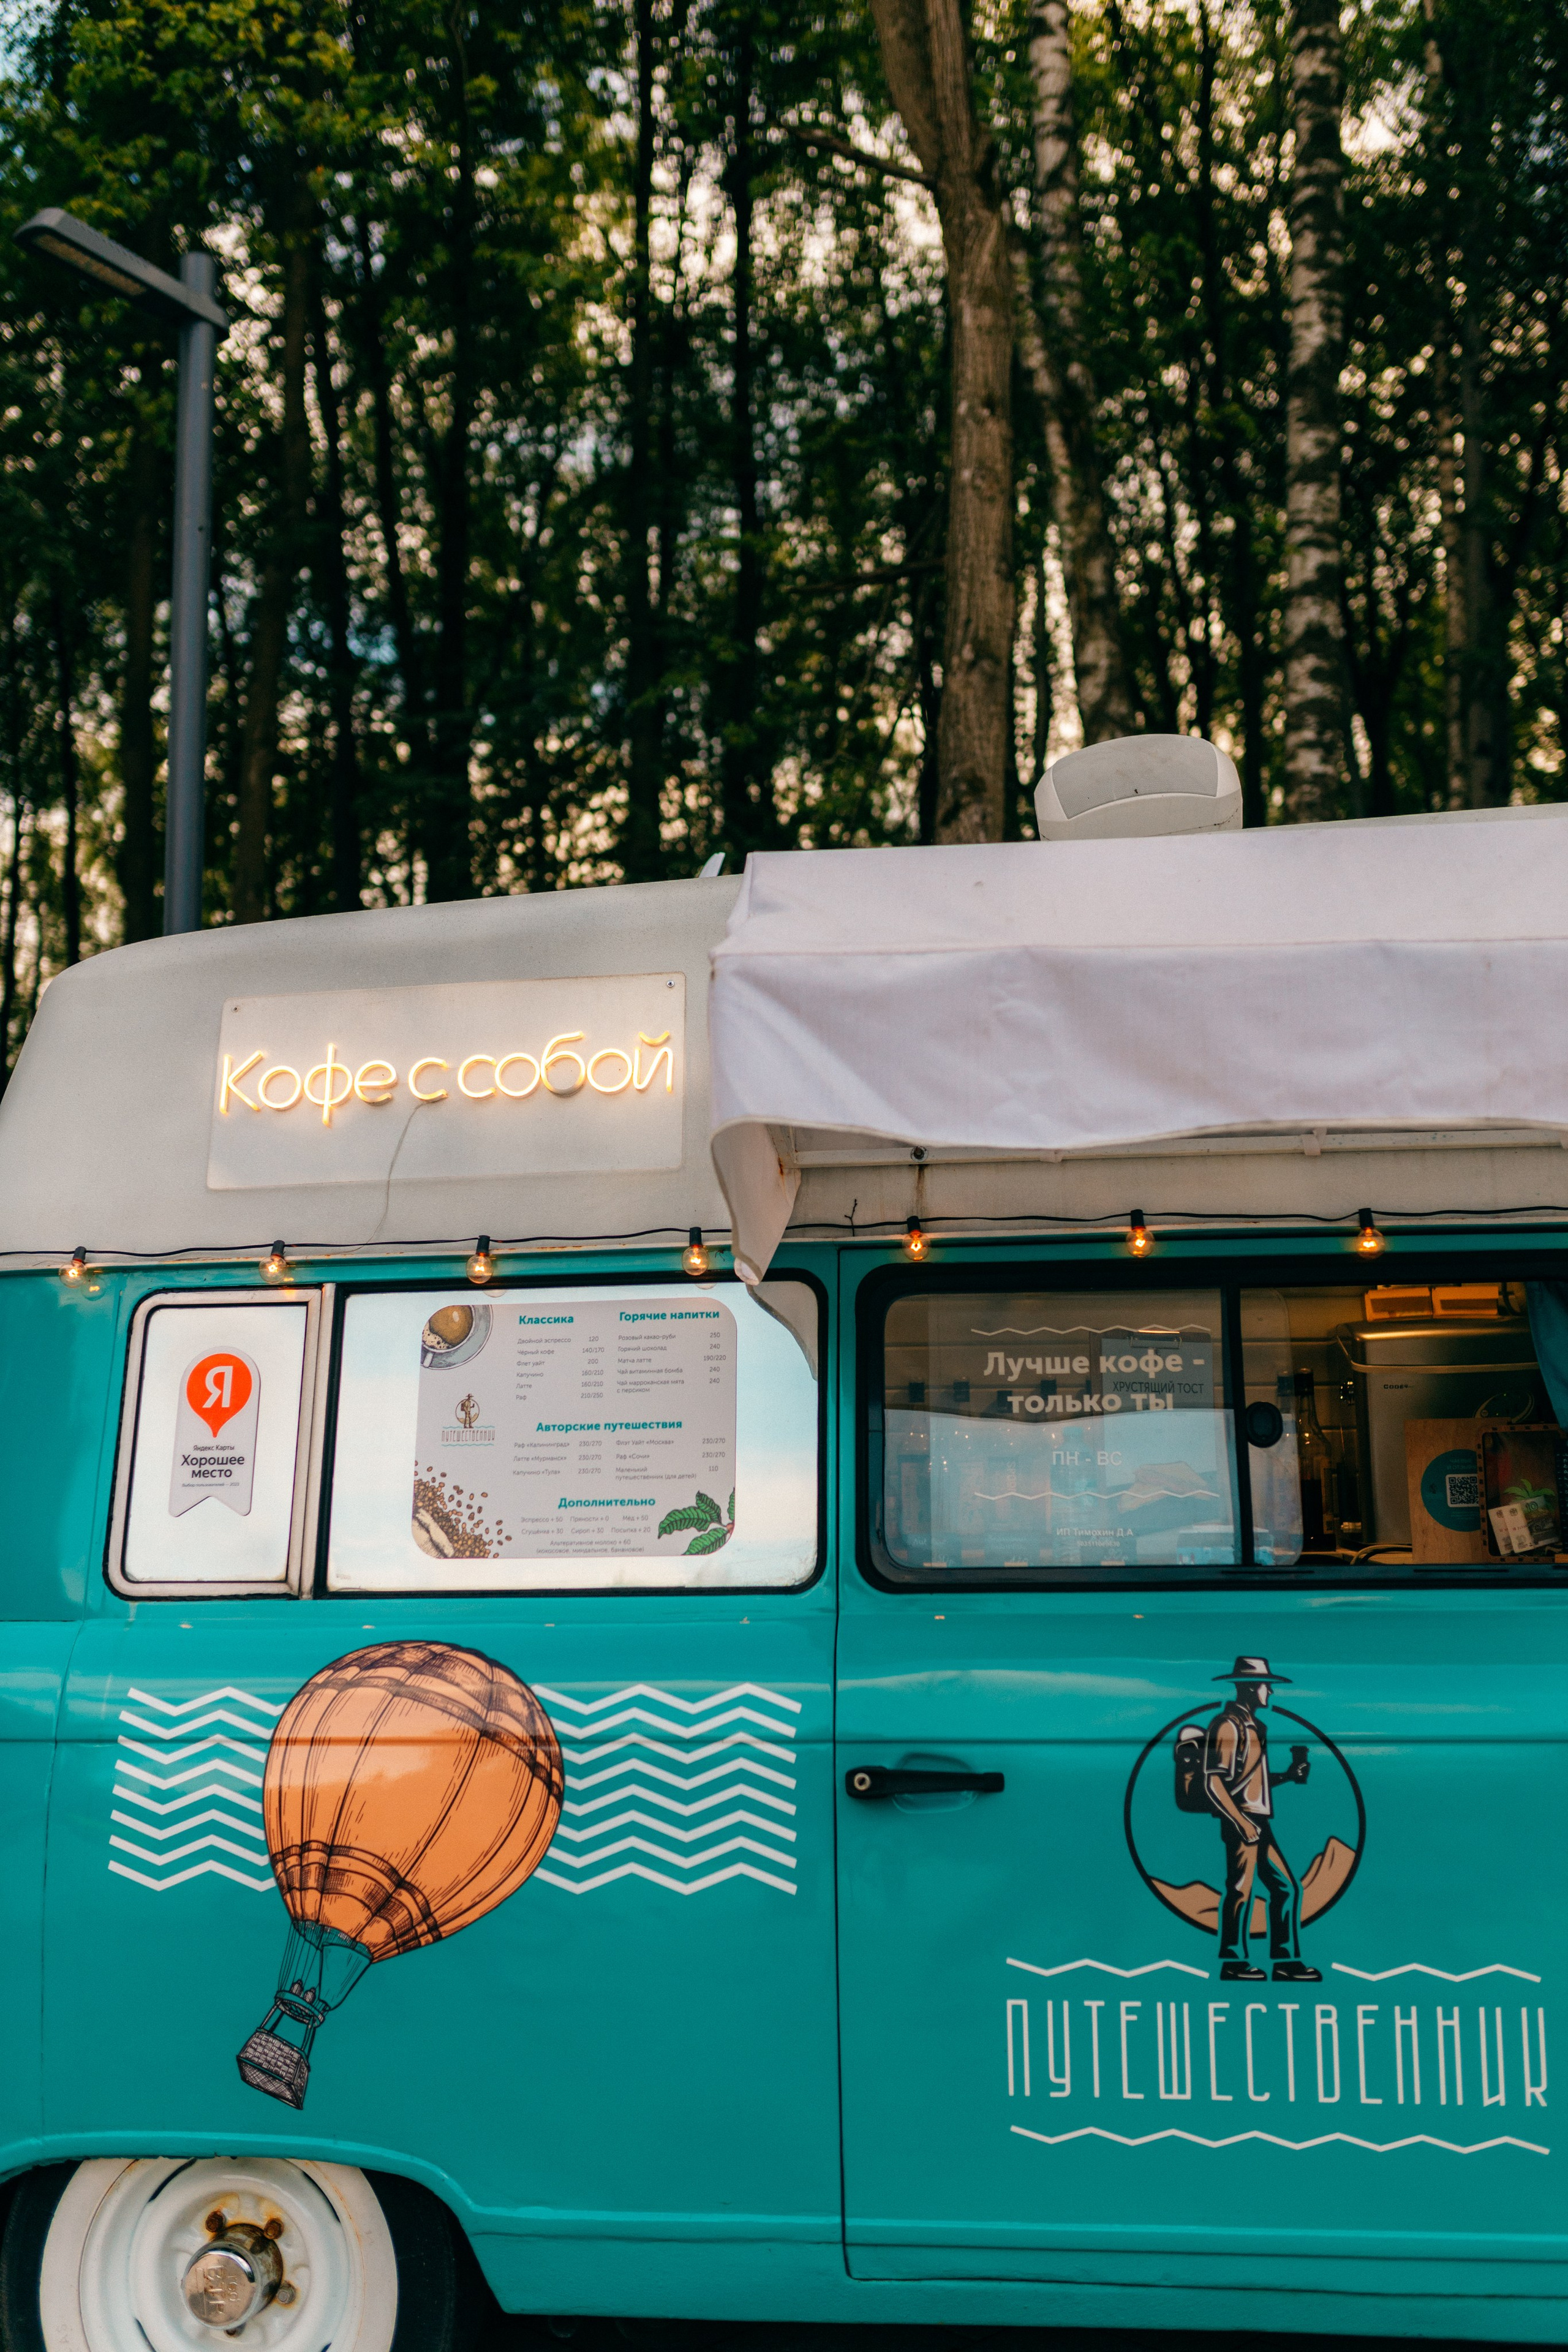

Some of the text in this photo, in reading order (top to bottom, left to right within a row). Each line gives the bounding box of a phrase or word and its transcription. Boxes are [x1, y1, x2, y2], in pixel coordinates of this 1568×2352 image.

[219, 1030, 674, 1127] Кофе с собой
[519, 1314, 574, 1325] Классика
[619, 1310, 720, 1323] Горячие напитки
[984, 1352, 1090, 1382] Лучше
[1099, 1349, 1183, 1378] кофе
[202, 1365, 233, 1408] Я
[1112, 1381, 1204, 1395] ХРУСТЯЩИЙ ТОСТ
[1007, 1393, 1174, 1414] только ты
[536, 1420, 682, 1433] Авторские путешествия
[181, 1454, 244, 1468] Хорошее
[1052, 1451, 1079, 1466] ПН
[1097, 1450, 1122, 1466] ВС
[192, 1469, 232, 1478] место
[558, 1498, 656, 1509] Дополнительно
[1073, 1528, 1114, 1536] Тимохин
[1006, 1999, 1549, 2107] ПУТЕШЕСТВЕННИК
